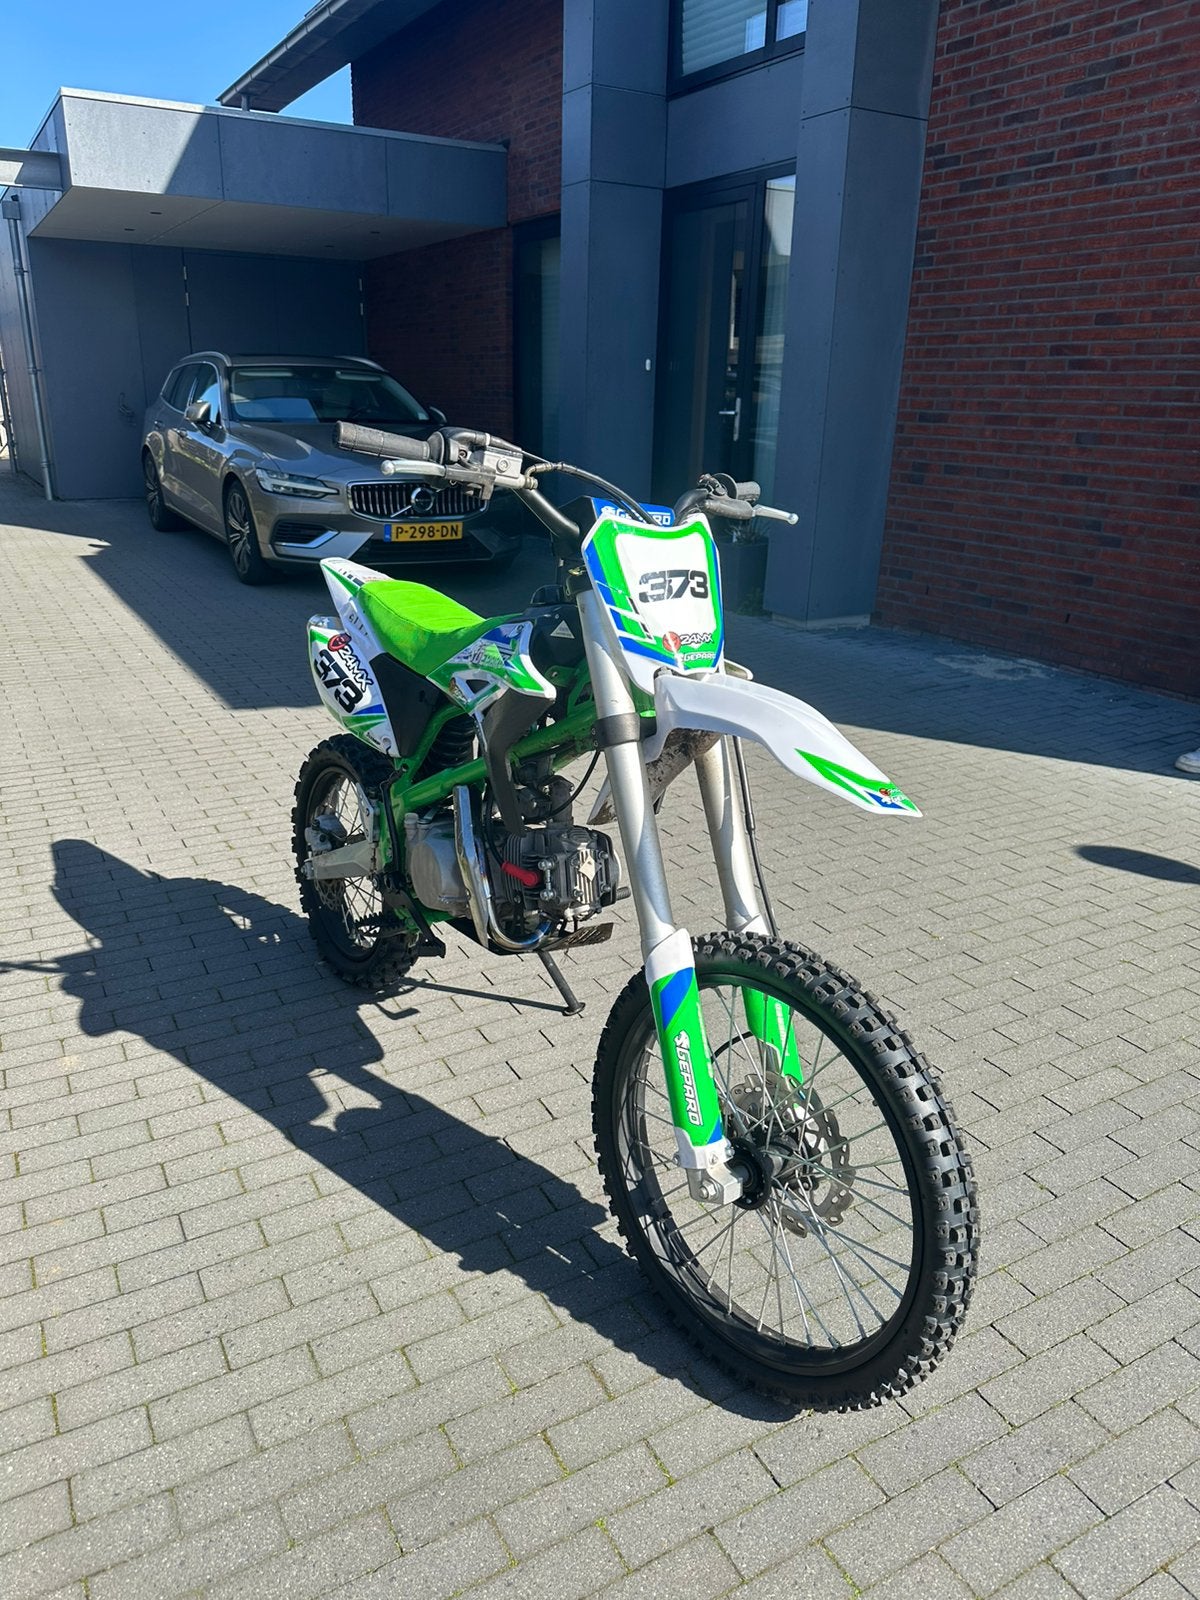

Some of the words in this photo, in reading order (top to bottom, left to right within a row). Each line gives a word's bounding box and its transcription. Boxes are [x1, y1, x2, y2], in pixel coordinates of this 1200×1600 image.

[395, 525, 459, 540] P-298-DN
[638, 569, 709, 603] 373
[313, 649, 364, 713] 373
[340, 644, 374, 693] 24MX
[676, 1047, 703, 1125] GEPARD
